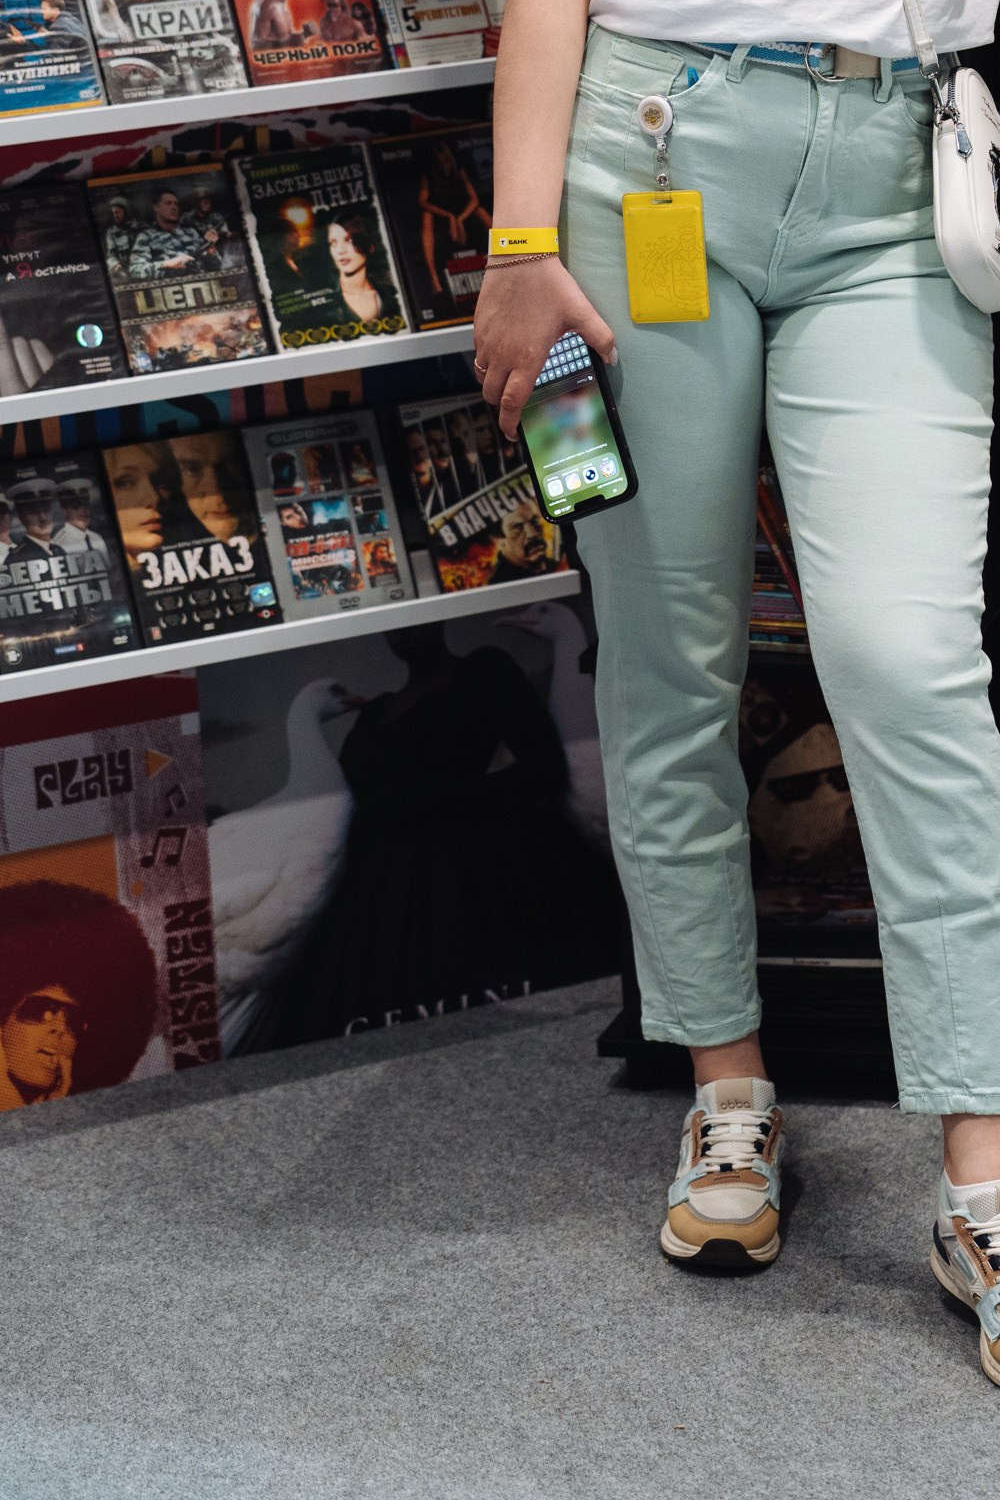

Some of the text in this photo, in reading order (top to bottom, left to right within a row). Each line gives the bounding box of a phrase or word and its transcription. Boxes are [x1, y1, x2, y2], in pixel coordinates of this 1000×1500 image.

[401, 5, 422, 32] 5
[253, 39, 379, 65] ЧЕРНЫЙ ПОЯС
[252, 163, 364, 200] ЗАСТЫВШИЕ
[310, 180, 369, 214] ДНИ
[2, 250, 41, 264] УМРУТ
[508, 238, 528, 246] БАНК
[5, 262, 91, 283] А Я ОСТАНУСЬ
[134, 279, 239, 316] ЦЕПЬ
[439, 526, 458, 547] В
[0, 549, 110, 588] БЕРЕГА
[137, 535, 255, 590] ЗАКАЗ
[0, 579, 113, 619] МЕЧТЫ
